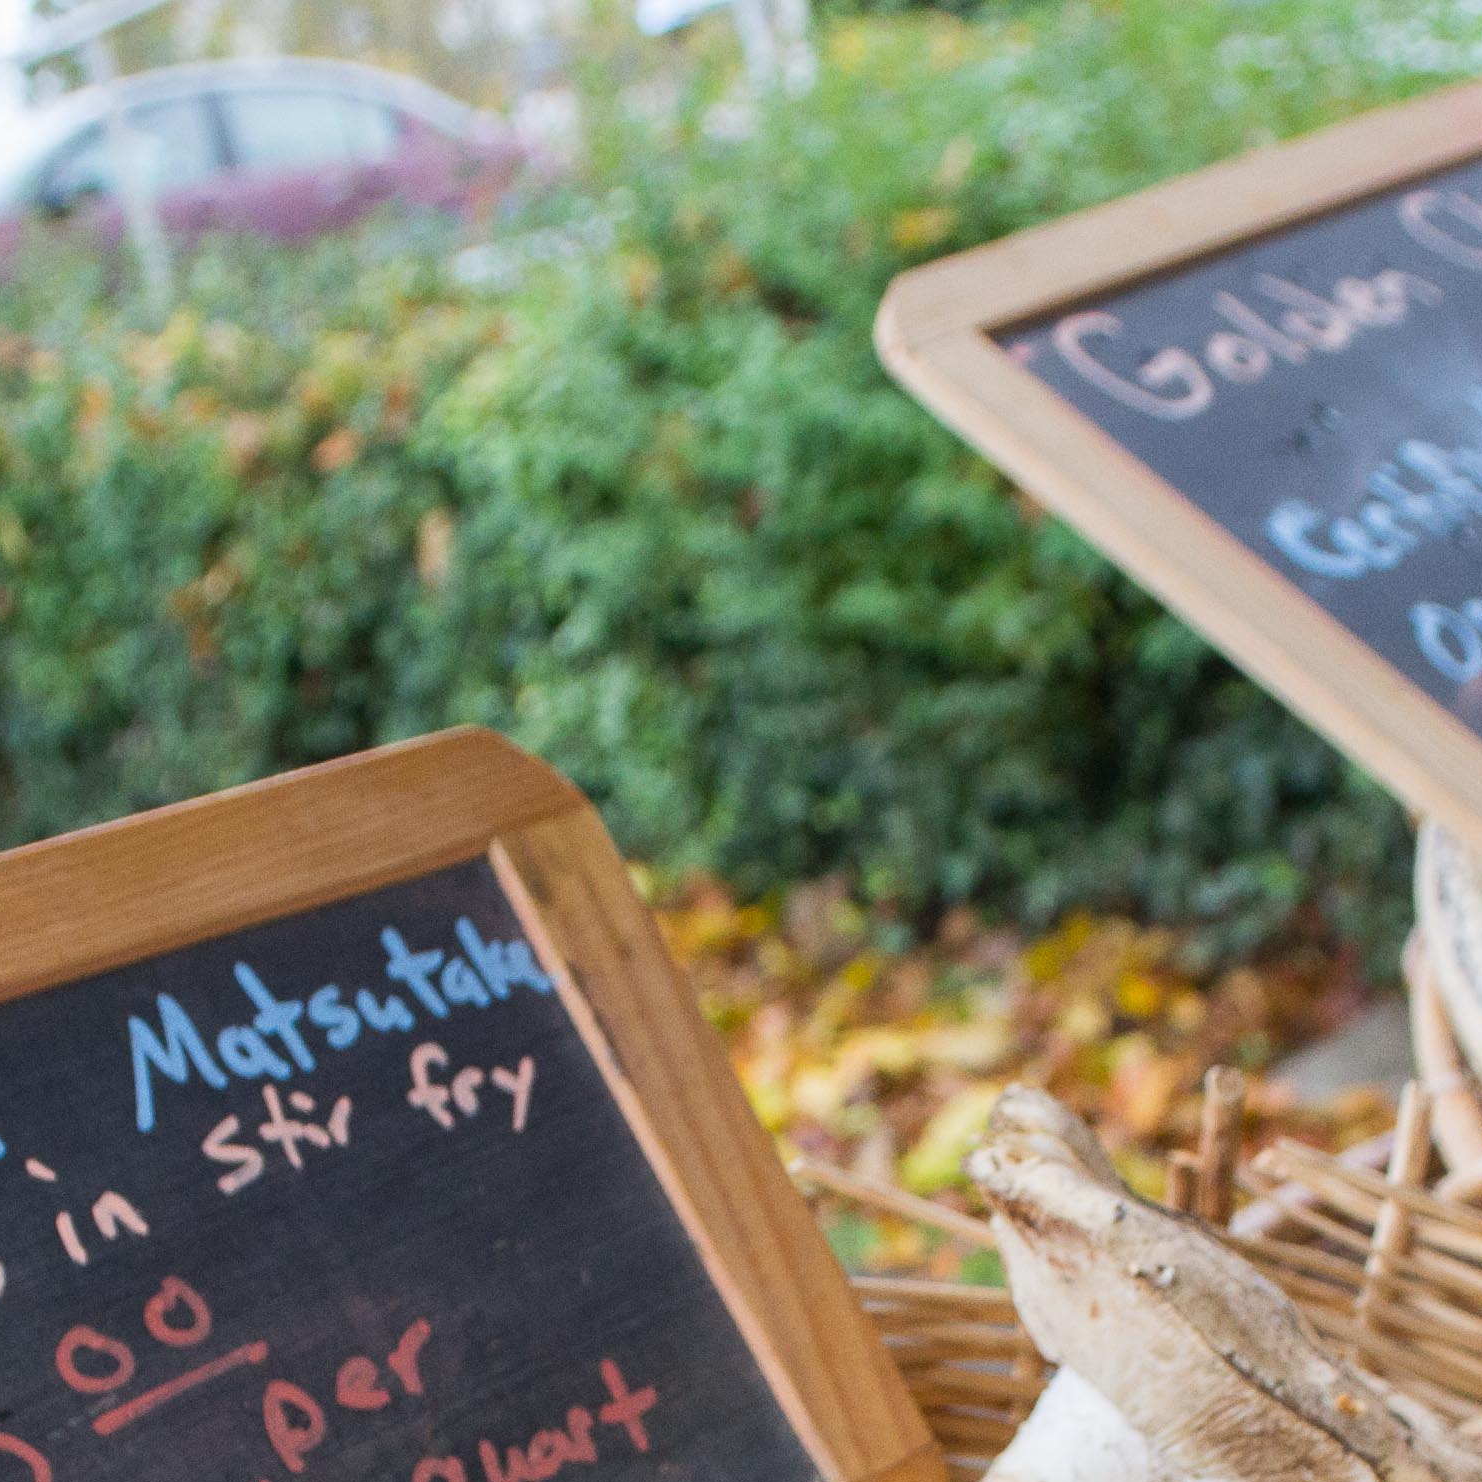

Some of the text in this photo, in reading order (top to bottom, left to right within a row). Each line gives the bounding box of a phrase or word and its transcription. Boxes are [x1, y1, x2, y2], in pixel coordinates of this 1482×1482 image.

[1054, 267, 1445, 422] Golden
[127, 915, 558, 1133] Matsutake
[25, 1157, 150, 1265] in
[406, 1041, 535, 1134] fry
[262, 1318, 432, 1474] per
